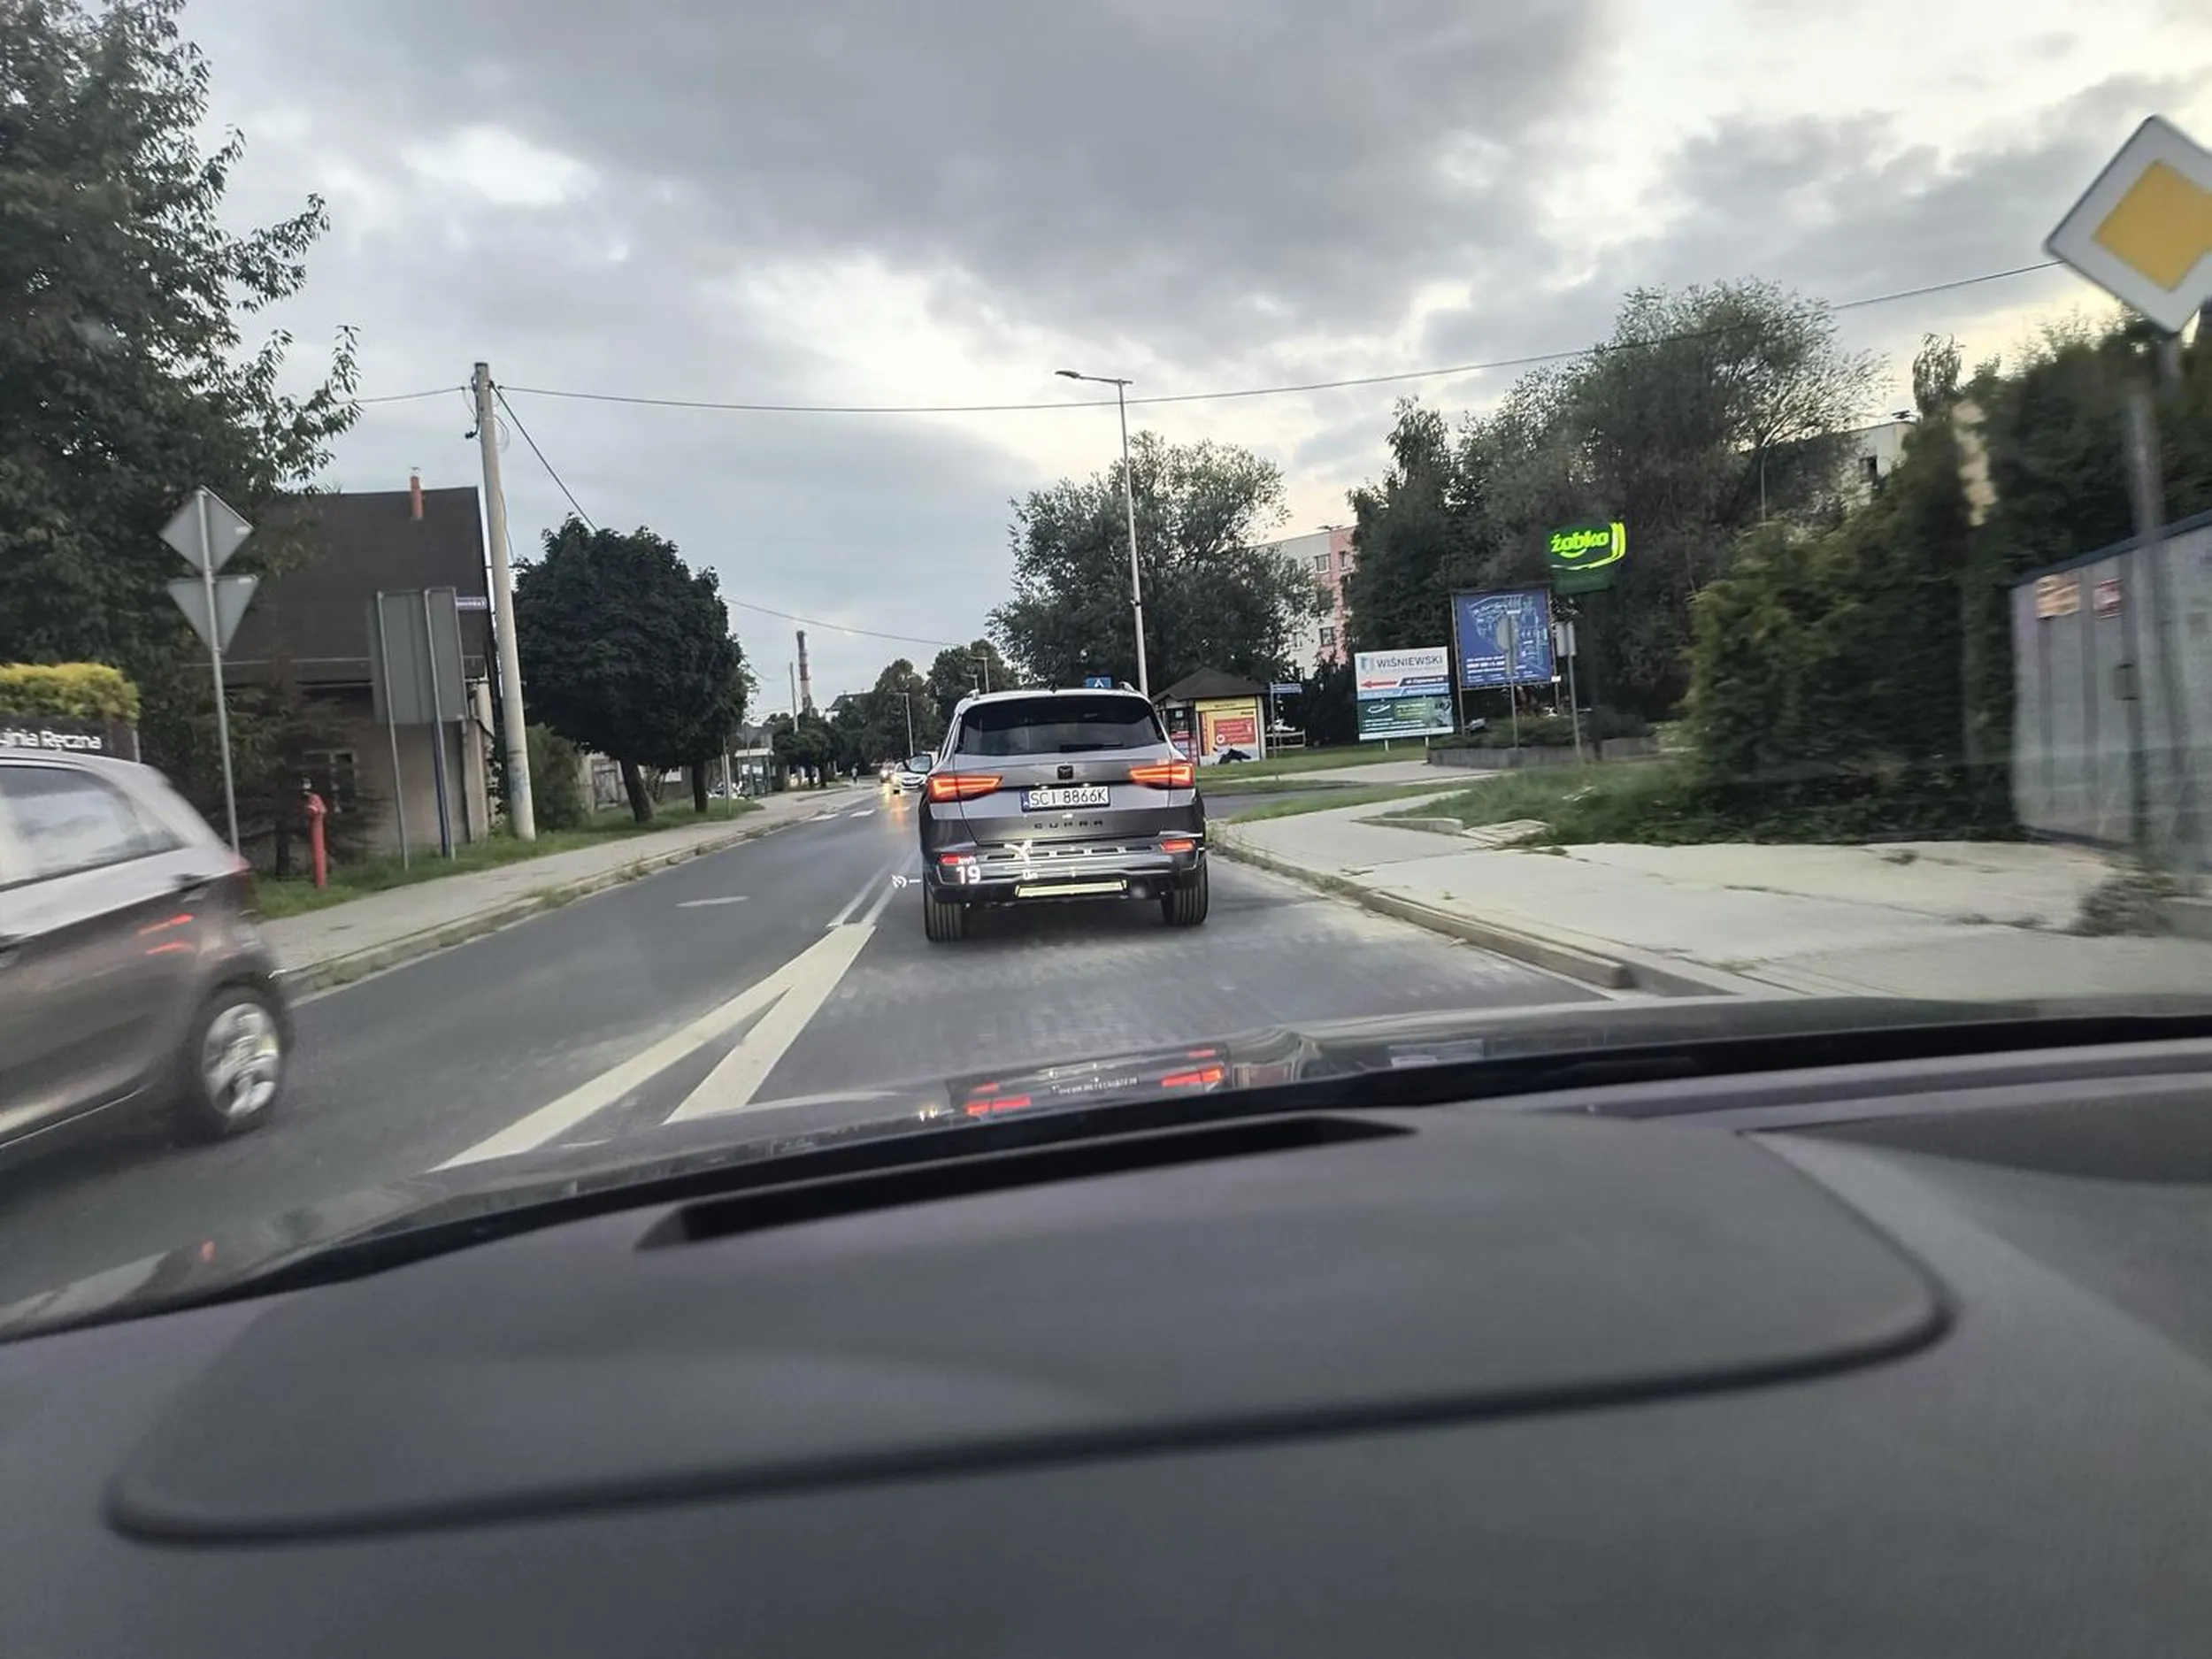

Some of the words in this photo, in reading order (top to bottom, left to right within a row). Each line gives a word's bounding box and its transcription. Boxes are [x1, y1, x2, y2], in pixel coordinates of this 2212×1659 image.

[1550, 531, 1609, 552] żabka
[1376, 656, 1444, 668] WIŚNIEWSKI
[1030, 791, 1056, 806] SCI
[1063, 787, 1107, 804] 8866K
[956, 866, 980, 884] 19
